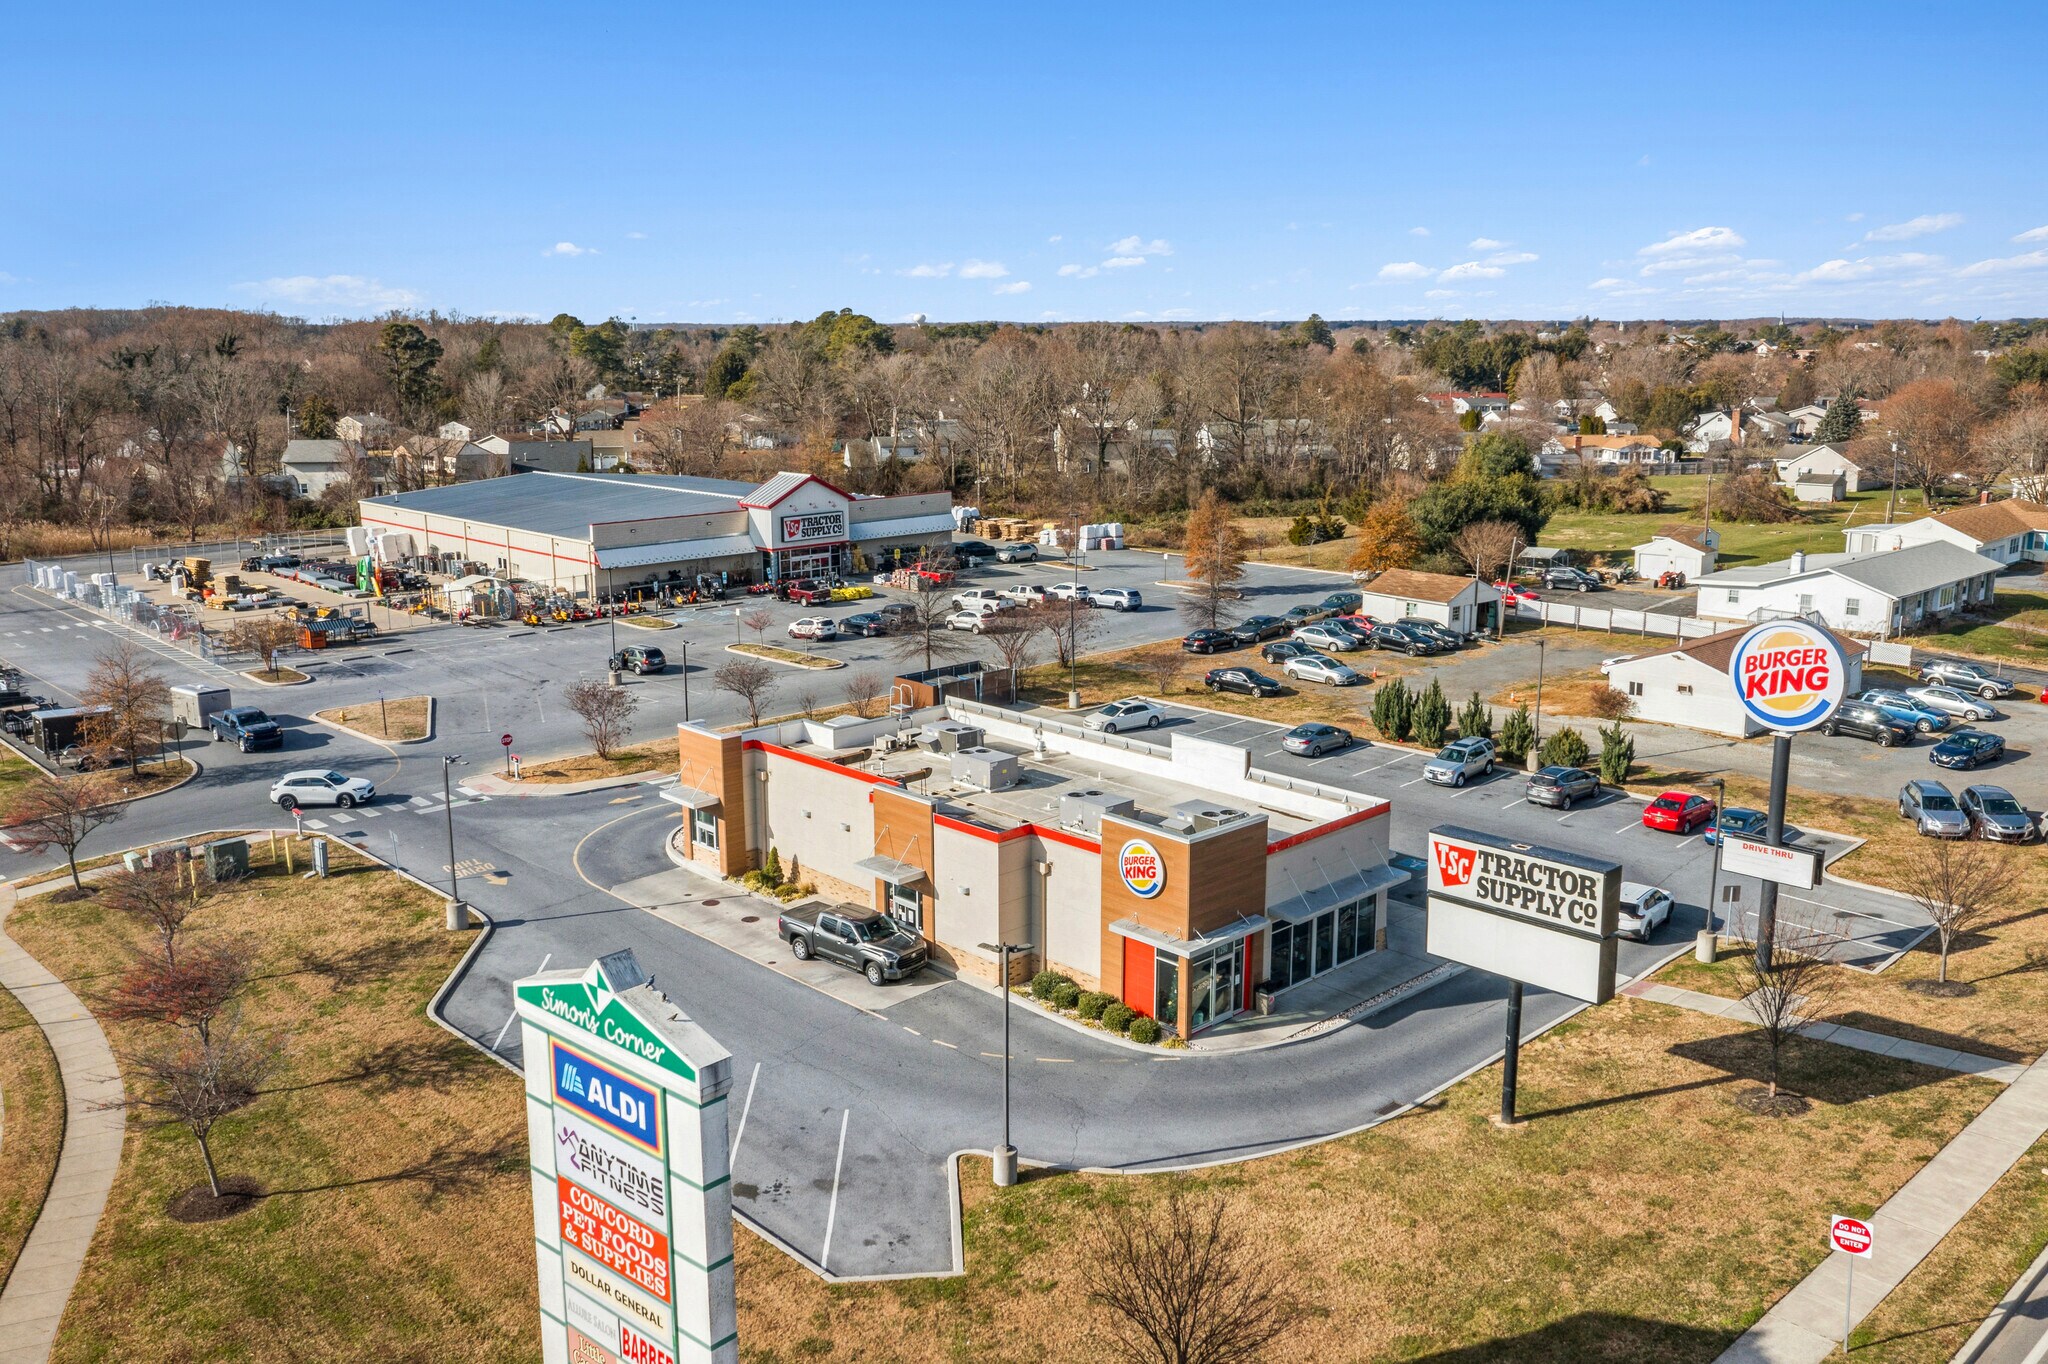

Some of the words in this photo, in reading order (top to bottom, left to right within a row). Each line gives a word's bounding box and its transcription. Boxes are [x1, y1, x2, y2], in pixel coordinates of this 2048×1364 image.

[786, 521, 799, 534] TSC
[801, 514, 842, 528] TRACTOR
[801, 525, 832, 538] SUPPLY
[1745, 648, 1828, 674] BURGER
[1745, 666, 1830, 700] KING
[1123, 855, 1156, 866] BURGER
[1437, 843, 1470, 883] TSC
[1742, 842, 1769, 855] DRIVE
[1770, 848, 1794, 860] THRU
[1124, 865, 1157, 880] KING
[1478, 849, 1598, 901] TRACTOR
[1476, 875, 1566, 919] SUPPLY
[541, 987, 600, 1035] Simon's
[604, 1017, 666, 1064] Corner
[587, 1076, 647, 1131] ALDI
[578, 1138, 664, 1198] ANYTIME
[580, 1159, 665, 1217] FITNESS
[569, 1186, 655, 1249] CONCORD
[1838, 1222, 1849, 1230] DO
[1851, 1225, 1866, 1235] NOT
[561, 1201, 597, 1236] PET
[600, 1224, 667, 1278] FOODS
[1840, 1238, 1863, 1250] ENTER
[564, 1222, 578, 1243] &
[581, 1232, 667, 1297] SUPPLIES
[570, 1260, 612, 1297] DOLLAR
[614, 1289, 664, 1329] GENERAL
[593, 1315, 617, 1341] SALON
